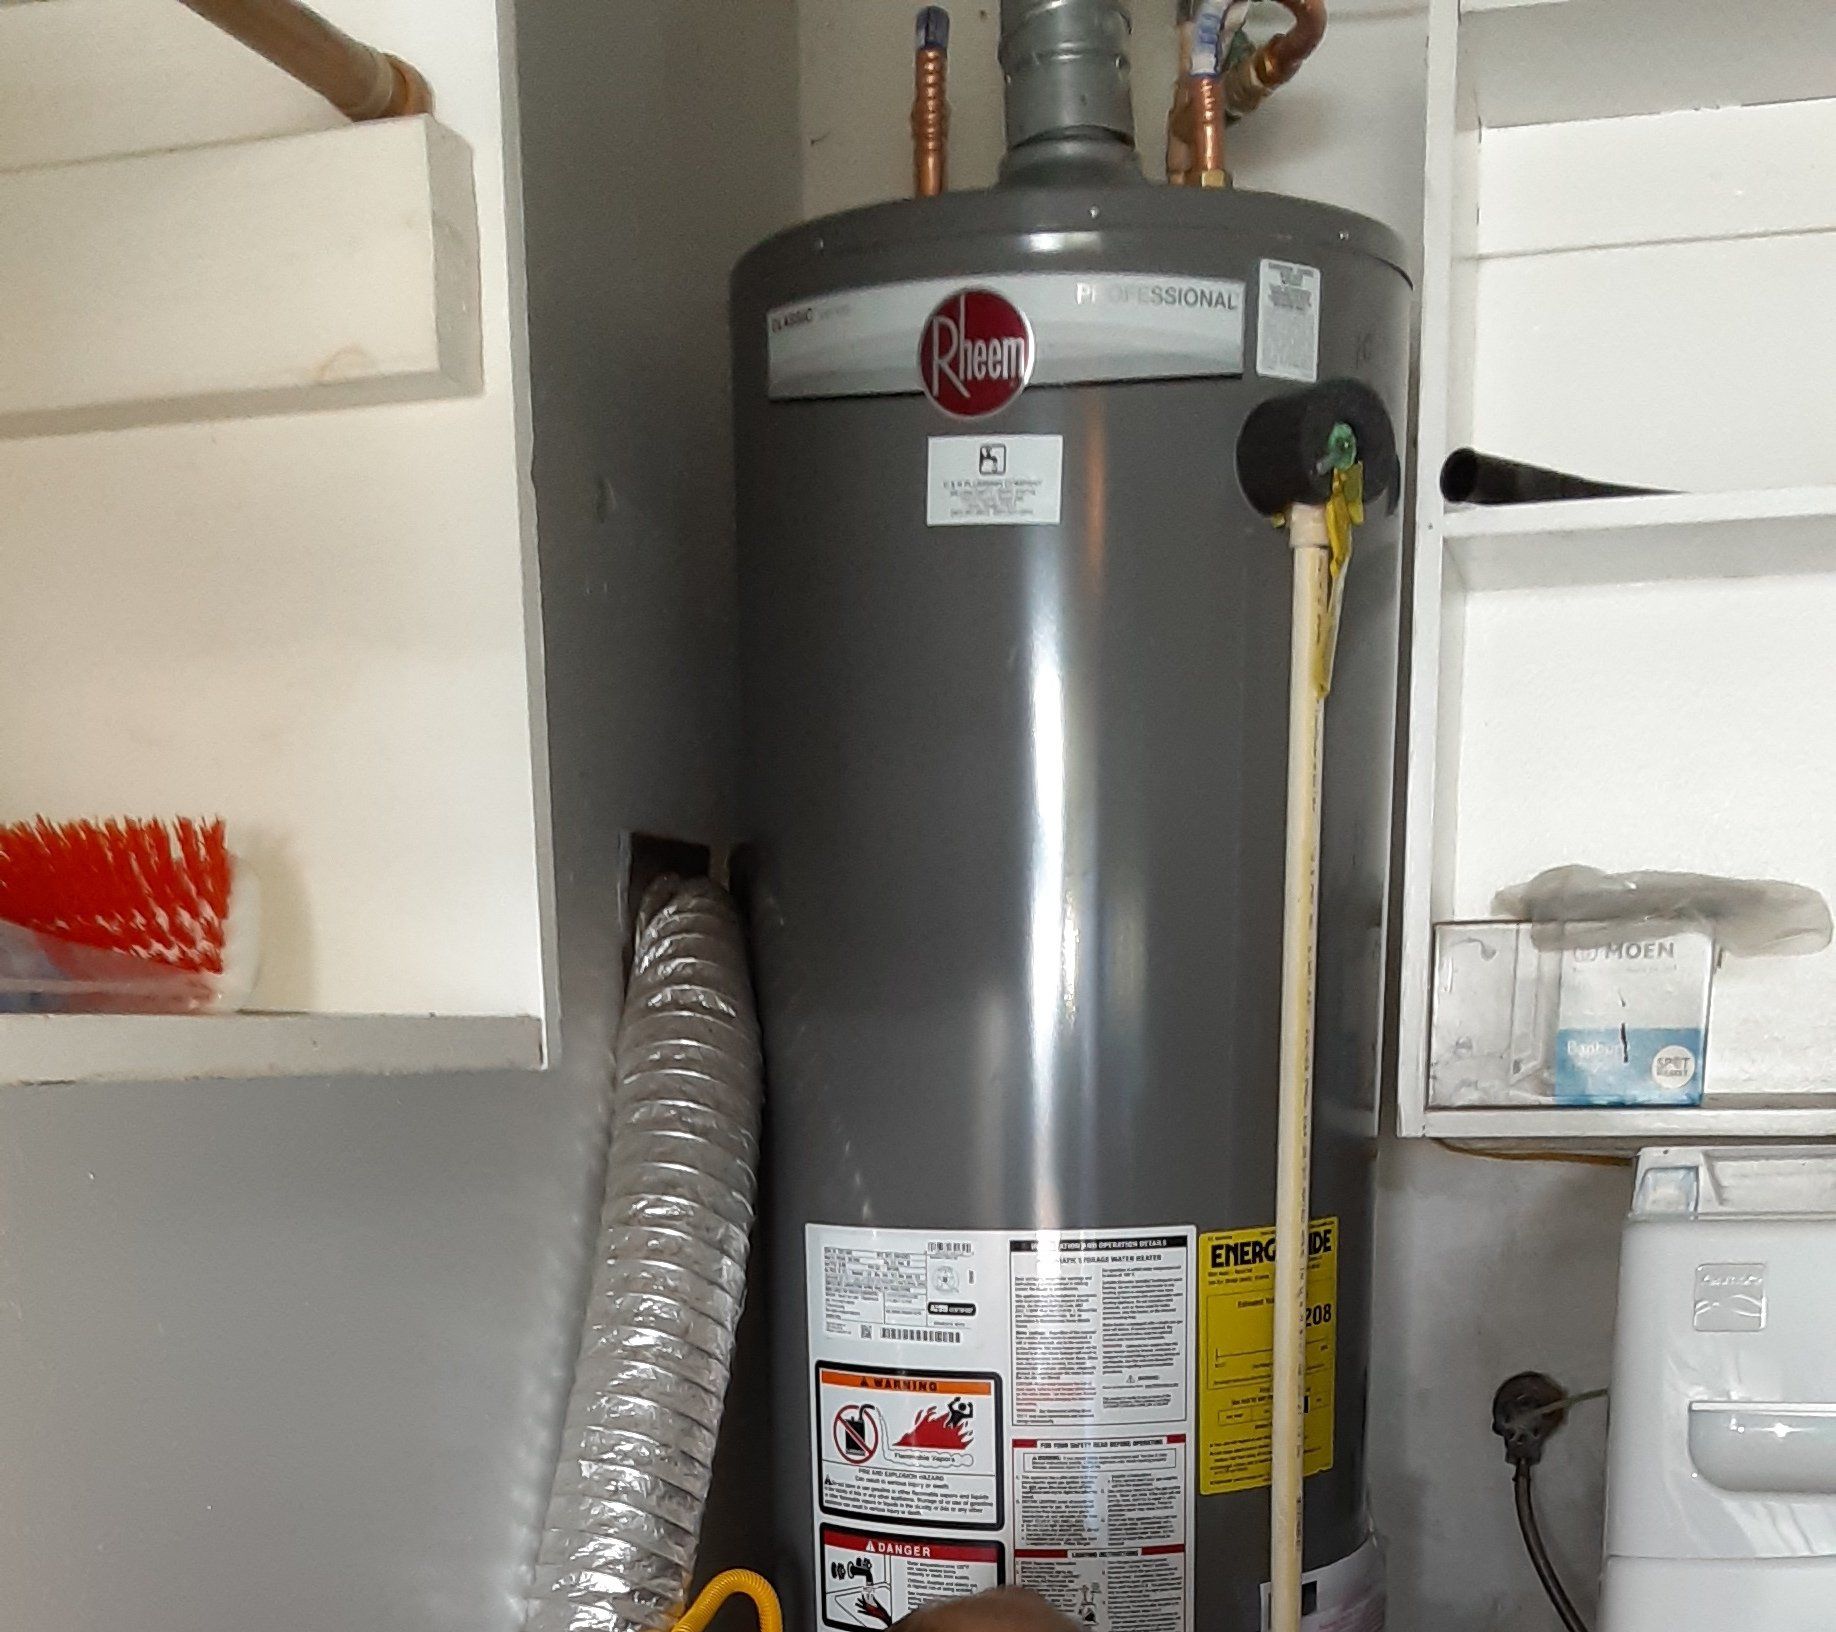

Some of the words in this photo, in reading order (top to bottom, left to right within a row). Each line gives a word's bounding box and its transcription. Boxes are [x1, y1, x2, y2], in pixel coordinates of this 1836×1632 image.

[932, 294, 1025, 398] Rheem
[1604, 942, 1675, 960] MOEN
[874, 1377, 938, 1392] WARNING
[878, 1542, 931, 1558] DANGER
